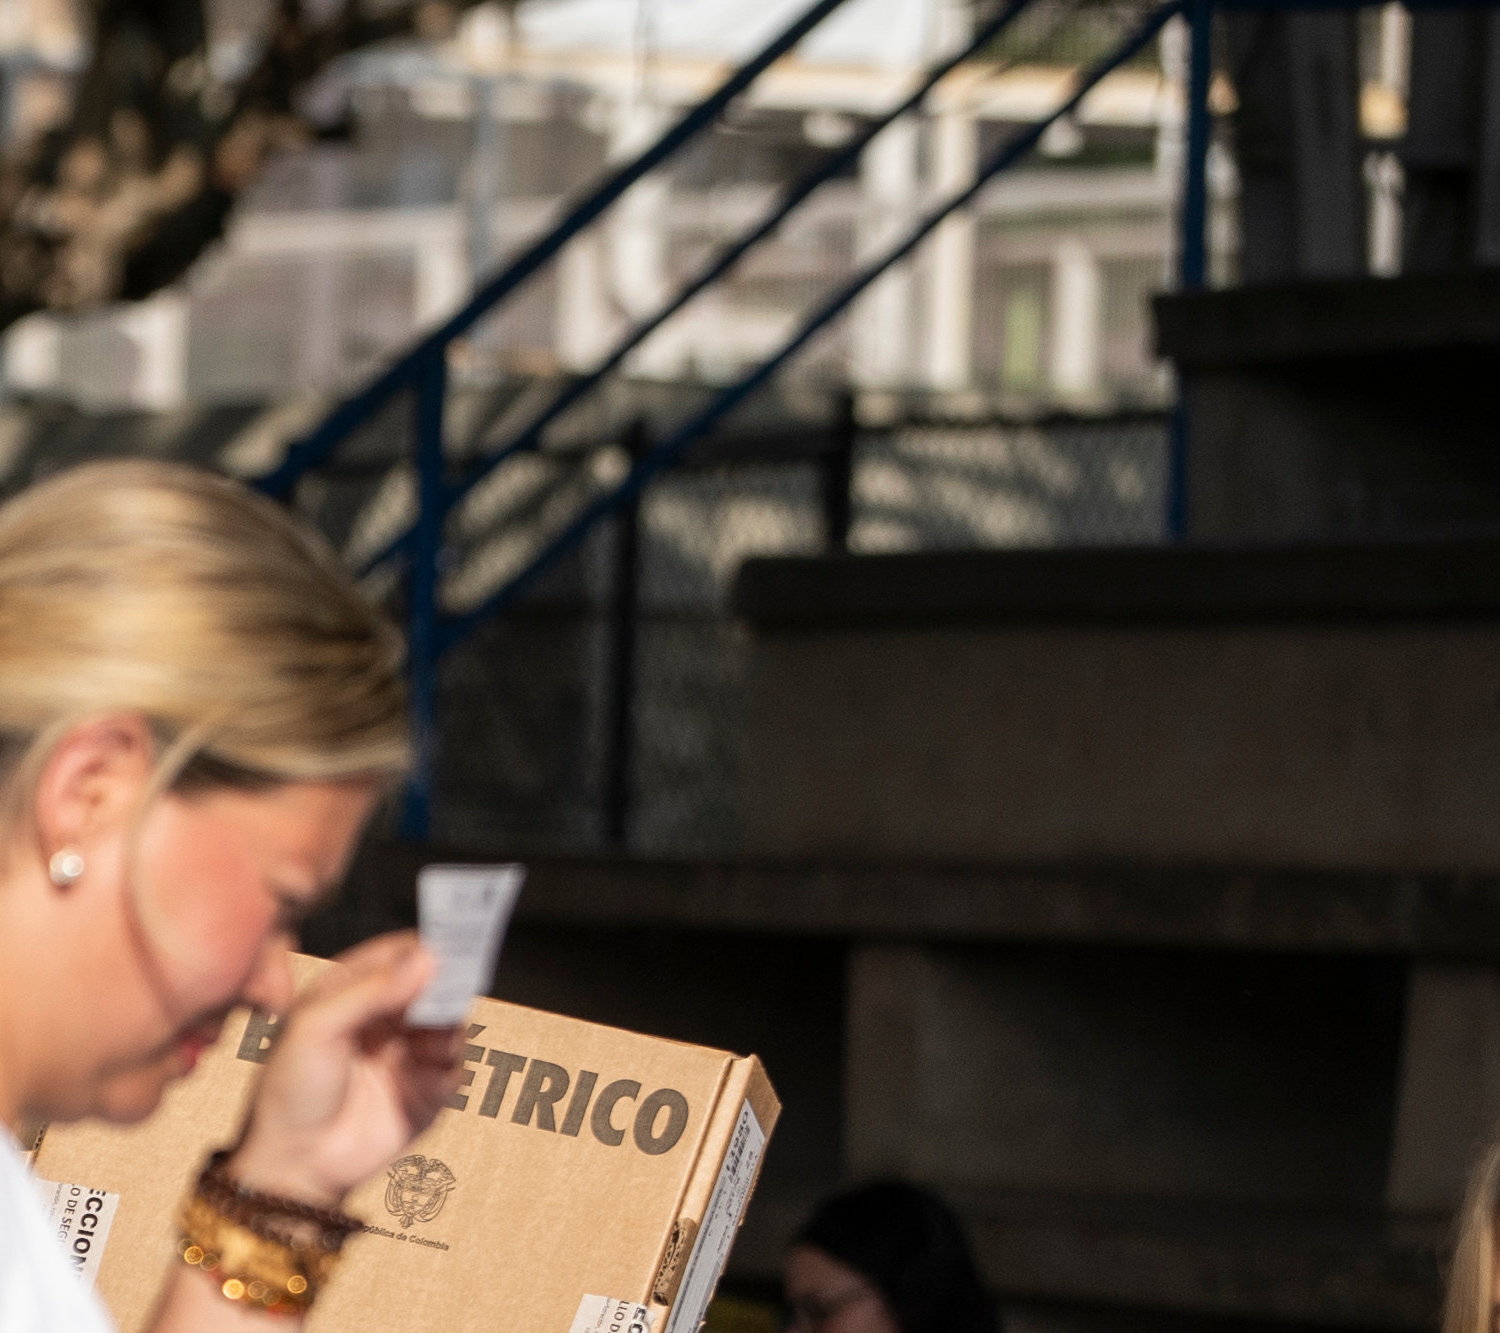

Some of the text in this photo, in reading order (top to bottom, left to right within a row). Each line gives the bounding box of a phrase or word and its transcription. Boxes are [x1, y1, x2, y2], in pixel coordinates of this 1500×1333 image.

[236, 1008, 689, 1156] BÉTRICO
[64, 1199, 78, 1216] DE
[409, 1234, 450, 1252] Colombia
